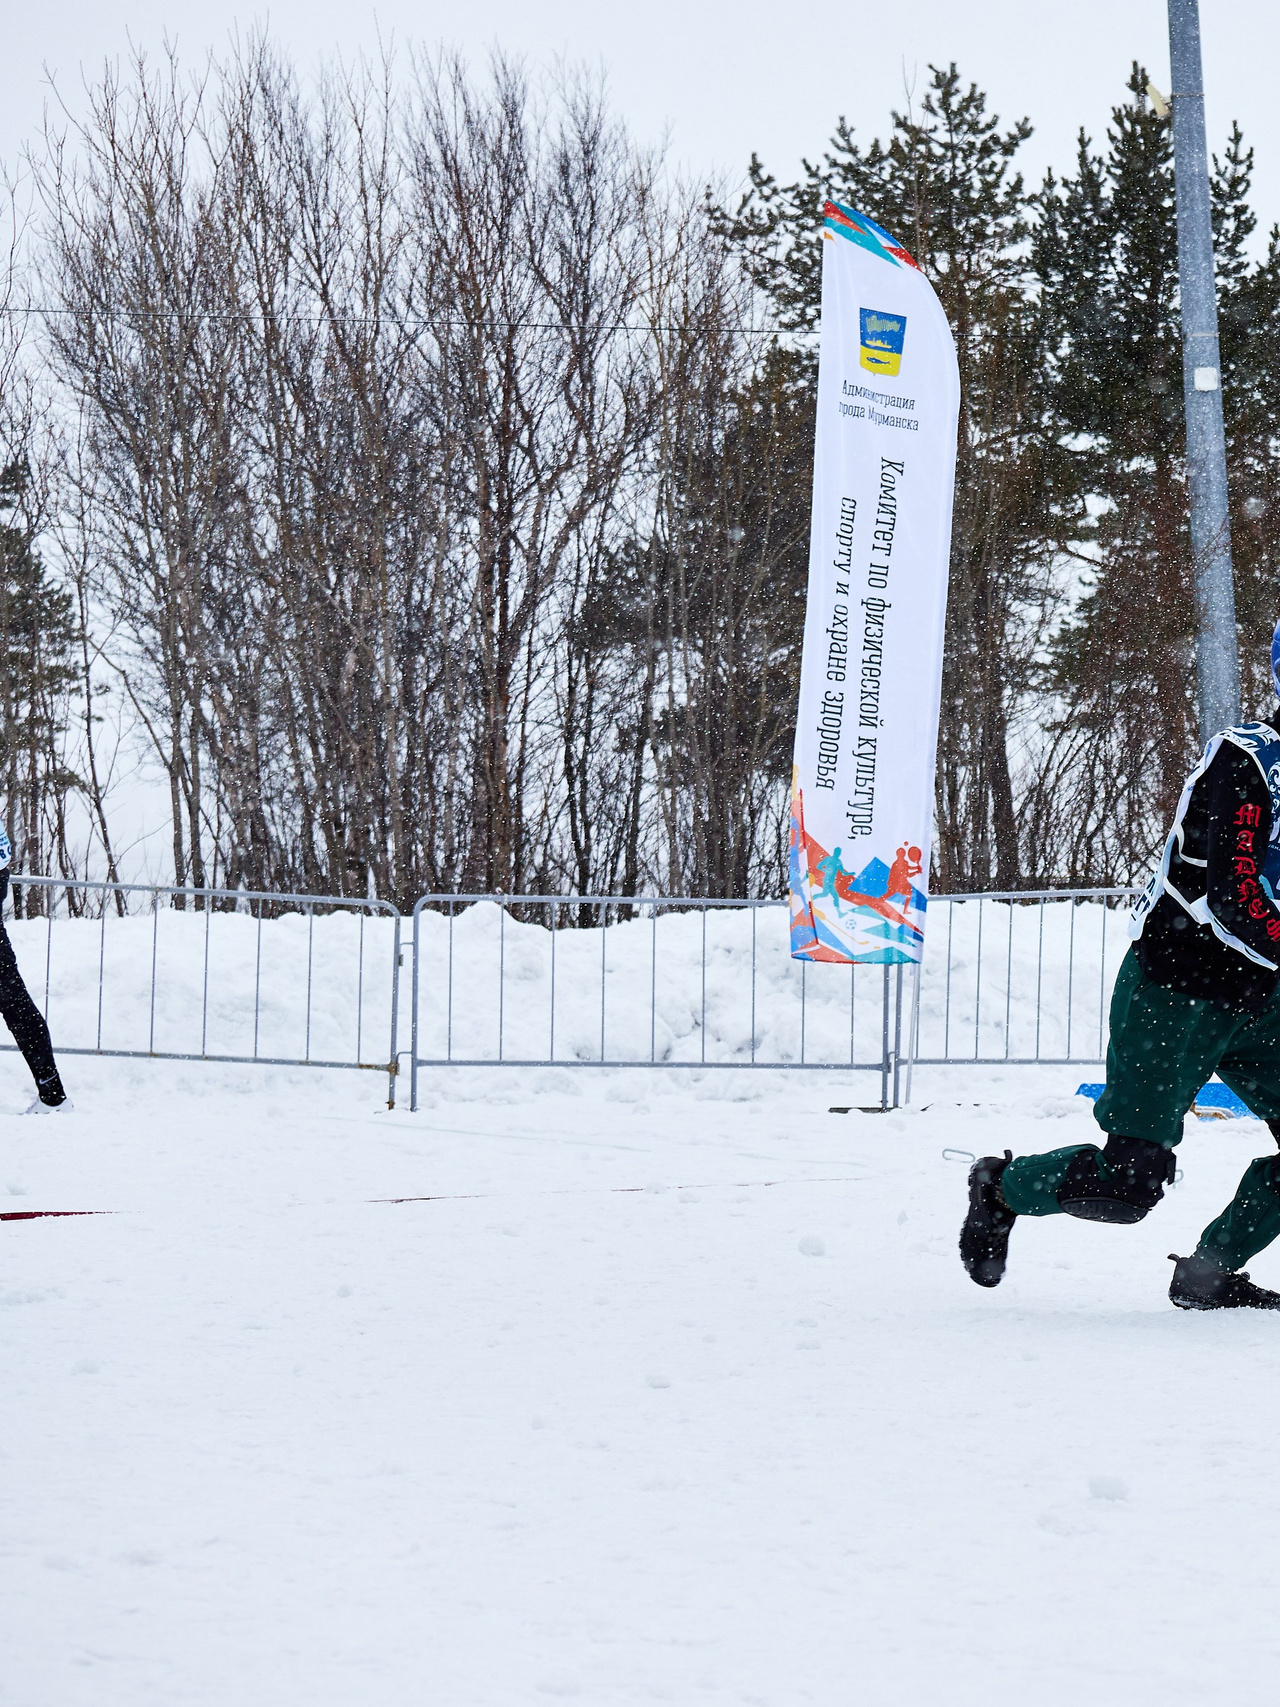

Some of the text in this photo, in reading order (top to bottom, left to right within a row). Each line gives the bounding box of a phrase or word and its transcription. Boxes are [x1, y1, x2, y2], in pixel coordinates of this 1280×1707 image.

[839, 401, 919, 431] грода Мурманска
[842, 380, 915, 410] Администрация
[816, 497, 857, 791] спорту и охране здоровья
[846, 456, 905, 840] Комитет по физической культуре,
